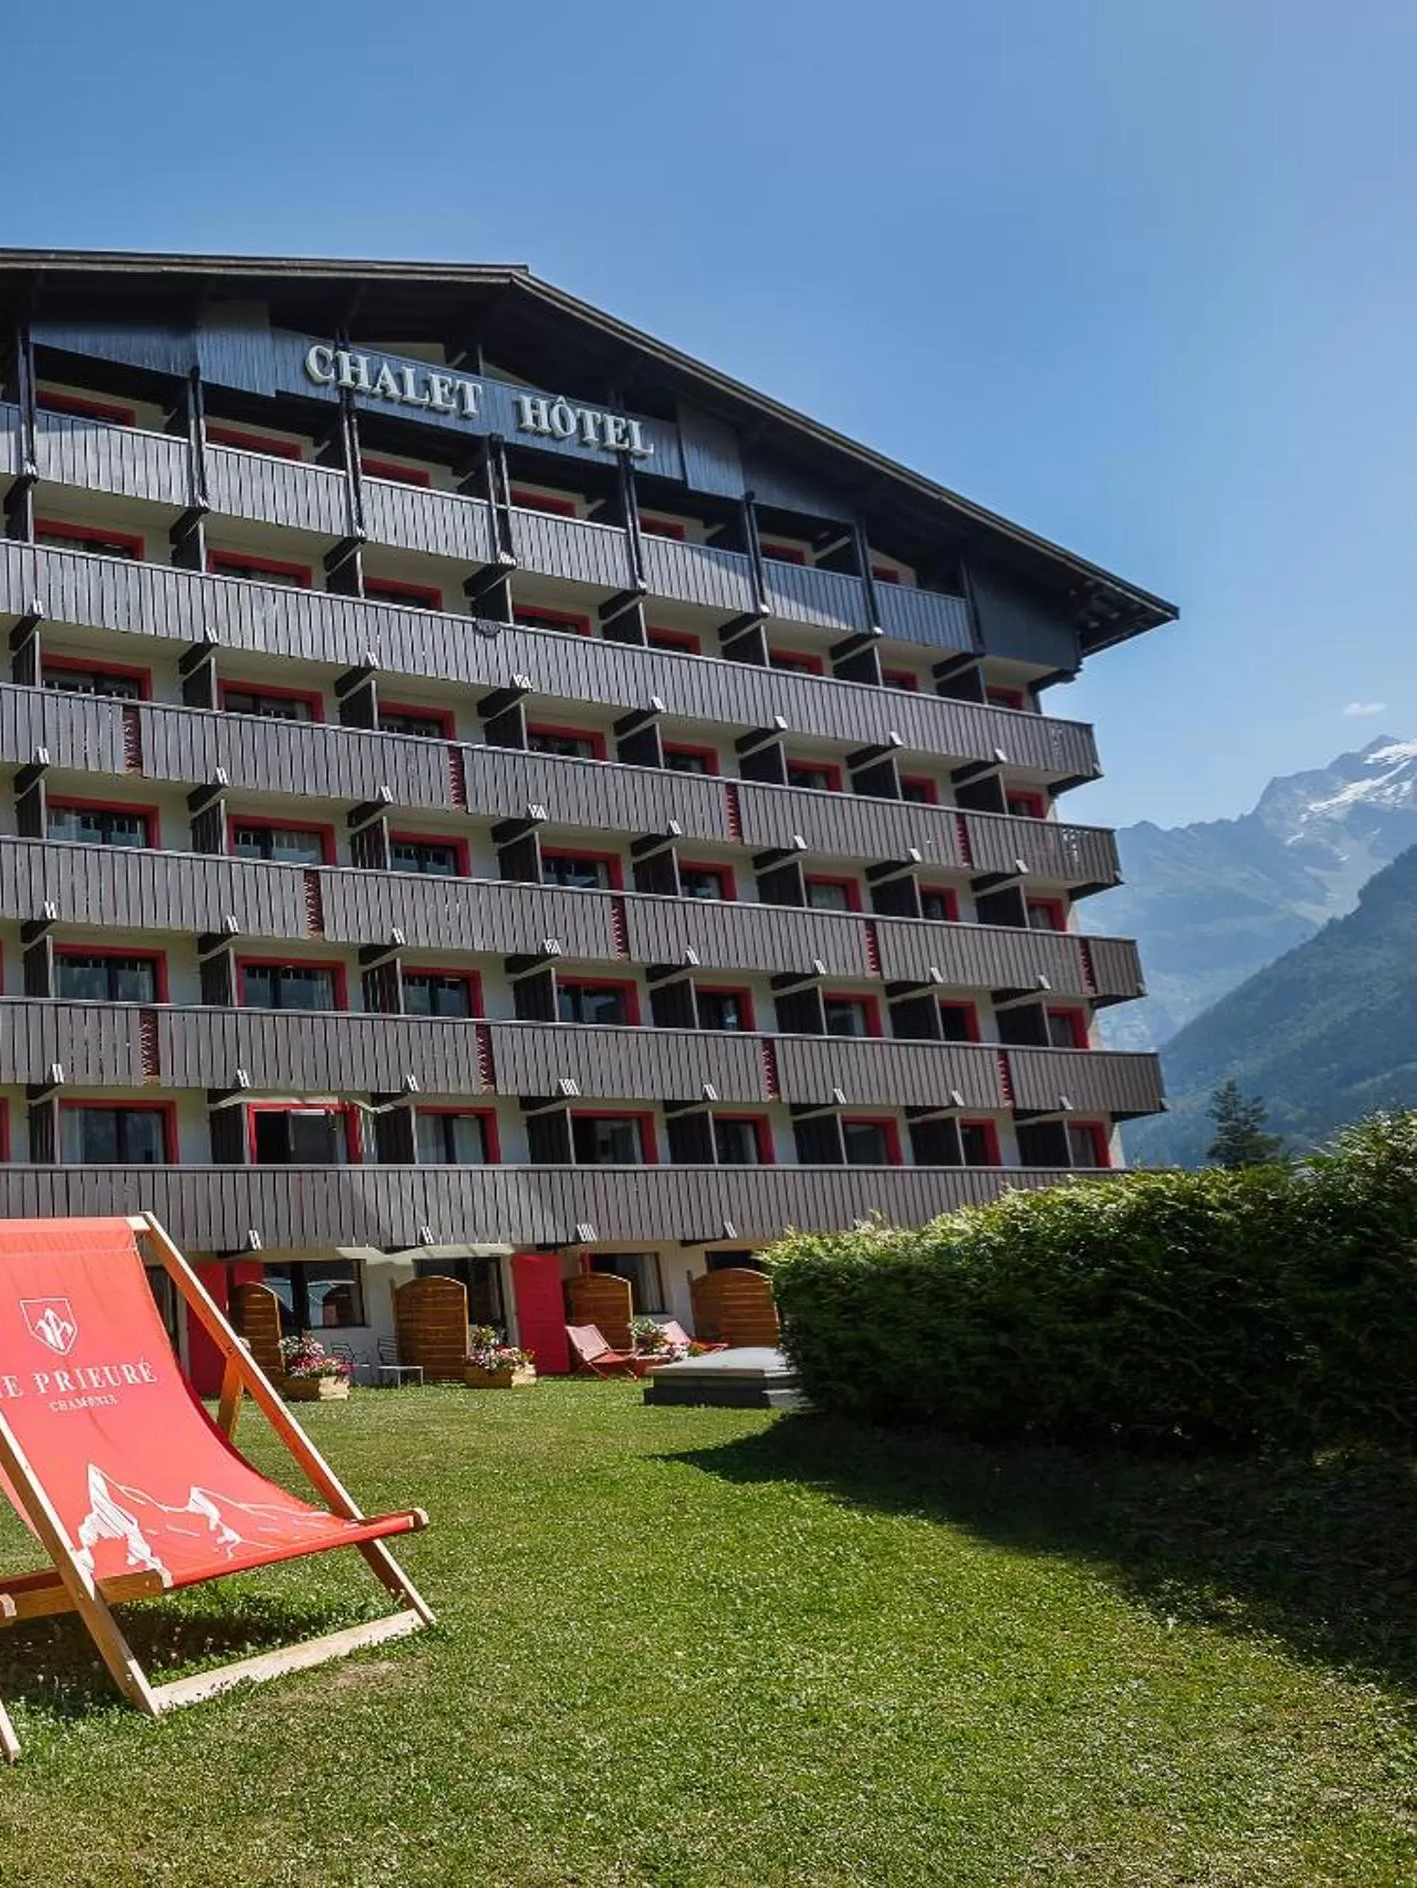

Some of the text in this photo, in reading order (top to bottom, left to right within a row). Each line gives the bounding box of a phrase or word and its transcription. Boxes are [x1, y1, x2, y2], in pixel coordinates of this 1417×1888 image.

[306, 345, 654, 457] CHALET HÔTEL
[32, 1358, 158, 1395] PRIEURÉ
